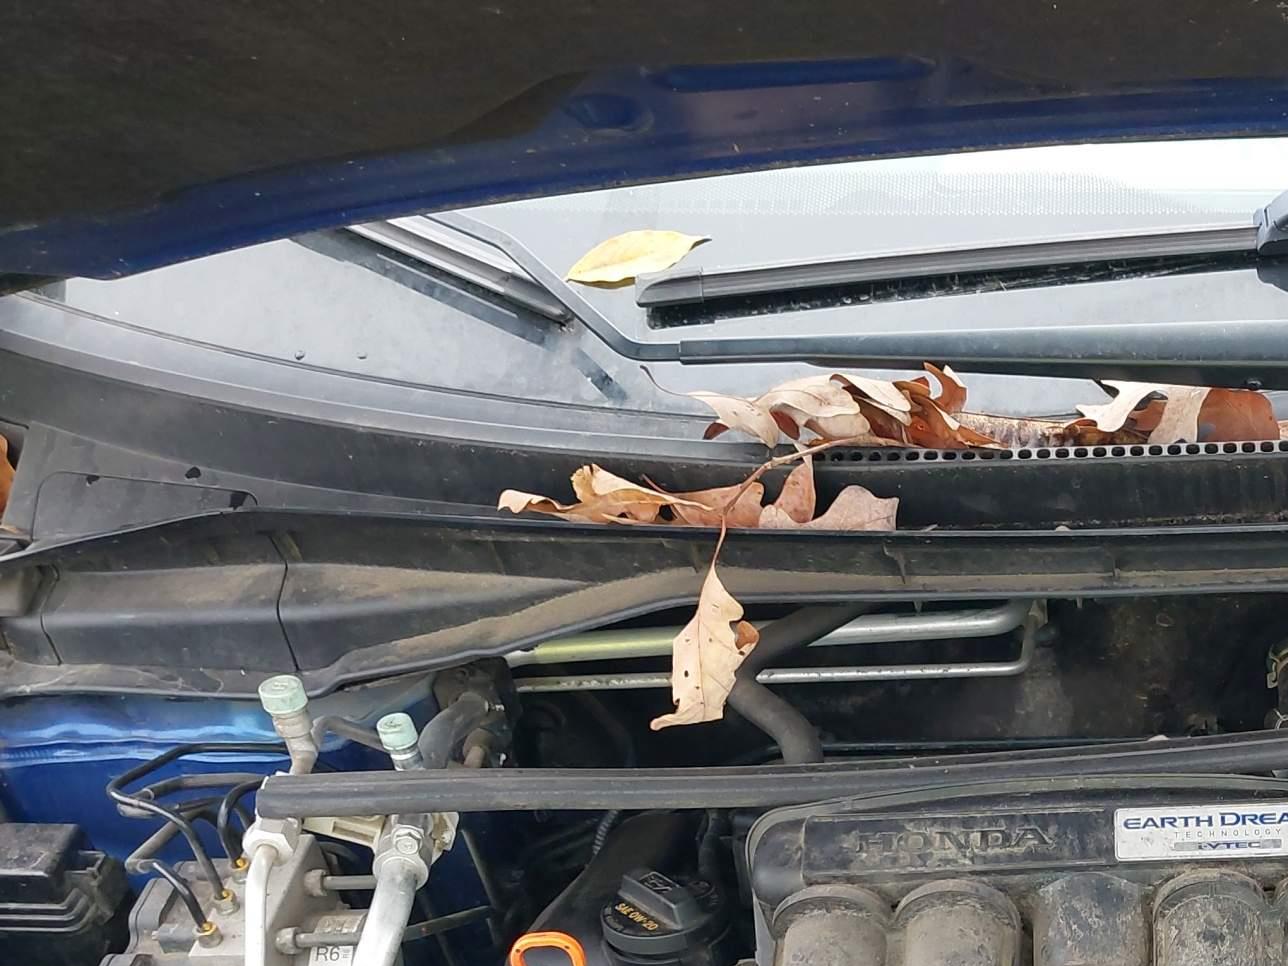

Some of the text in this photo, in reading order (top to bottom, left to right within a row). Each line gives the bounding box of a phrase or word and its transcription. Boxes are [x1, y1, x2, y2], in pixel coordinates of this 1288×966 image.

[1123, 815, 1214, 830] EARTH
[856, 825, 1056, 853] HONDA
[1174, 828, 1282, 838] TECHNOLOGY
[615, 903, 634, 915] SAE
